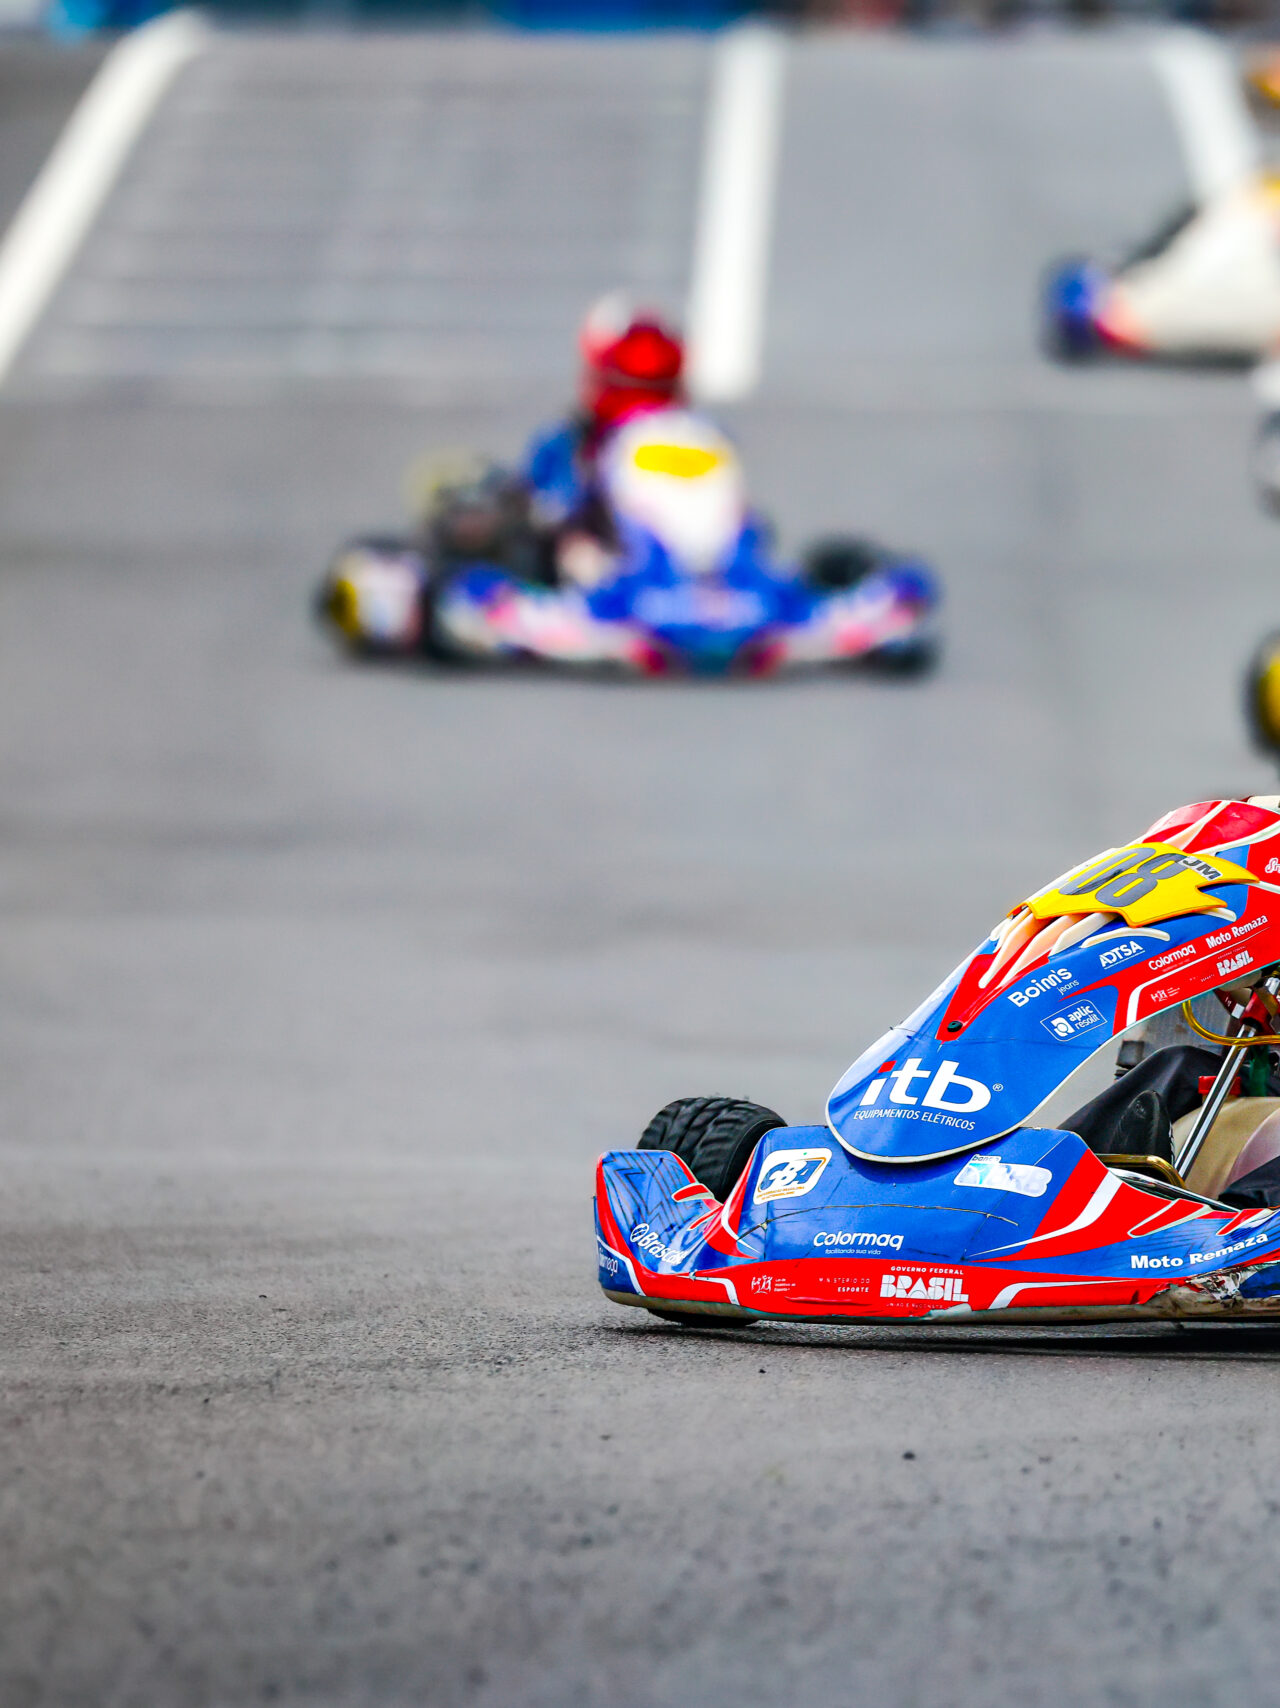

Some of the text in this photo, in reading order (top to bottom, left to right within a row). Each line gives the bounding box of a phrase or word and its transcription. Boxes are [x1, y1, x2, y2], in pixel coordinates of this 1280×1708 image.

[1058, 847, 1188, 907] 08
[1183, 858, 1222, 881] JM
[1205, 915, 1268, 949] Moto Remaza
[1099, 941, 1143, 968] ADTSA
[1148, 941, 1196, 971] Colormaq
[1216, 950, 1254, 977] BRASIL
[1057, 979, 1080, 996] jeans
[1069, 1005, 1094, 1022] aplic
[1074, 1013, 1101, 1031] resolit
[859, 1058, 992, 1113] itb
[853, 1108, 976, 1131] EQUIPAMENTOS ELÉTRICOS
[813, 1231, 904, 1250] Colormaq
[1131, 1233, 1269, 1270] Moto Remaza
[929, 1267, 964, 1275] FEDERAL
[880, 1274, 969, 1302] BRASIL
